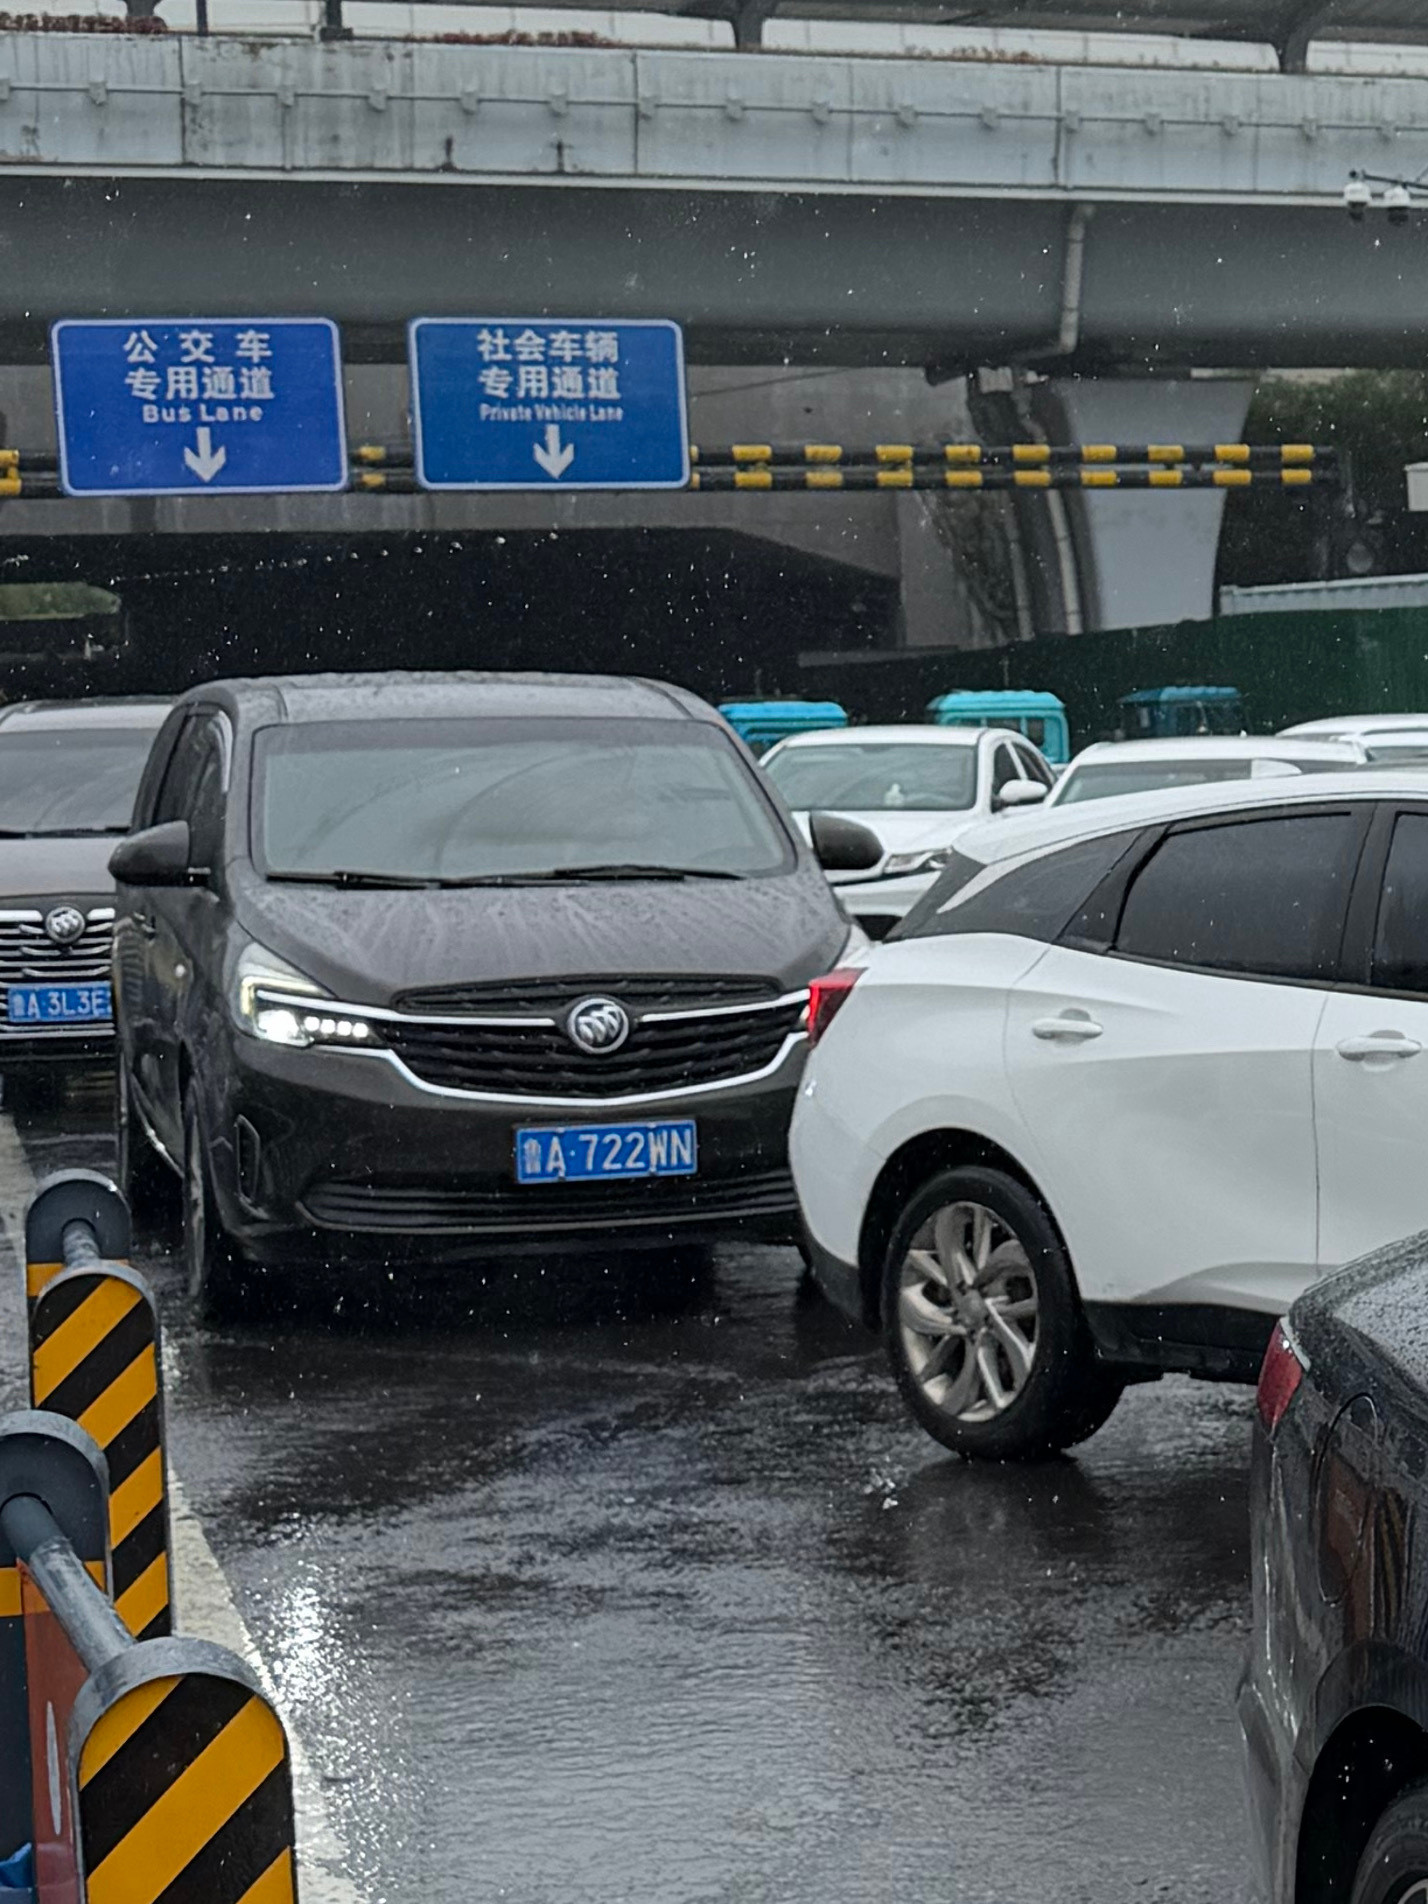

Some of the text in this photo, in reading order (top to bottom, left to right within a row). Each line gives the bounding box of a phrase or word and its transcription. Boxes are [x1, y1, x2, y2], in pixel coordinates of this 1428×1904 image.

[123, 329, 273, 363] 公交车
[477, 328, 619, 363] 社会车辆
[124, 367, 275, 400] 专用通道
[478, 365, 621, 399] 专用通道
[142, 403, 263, 423] Bus Lane
[589, 404, 623, 421] Lane
